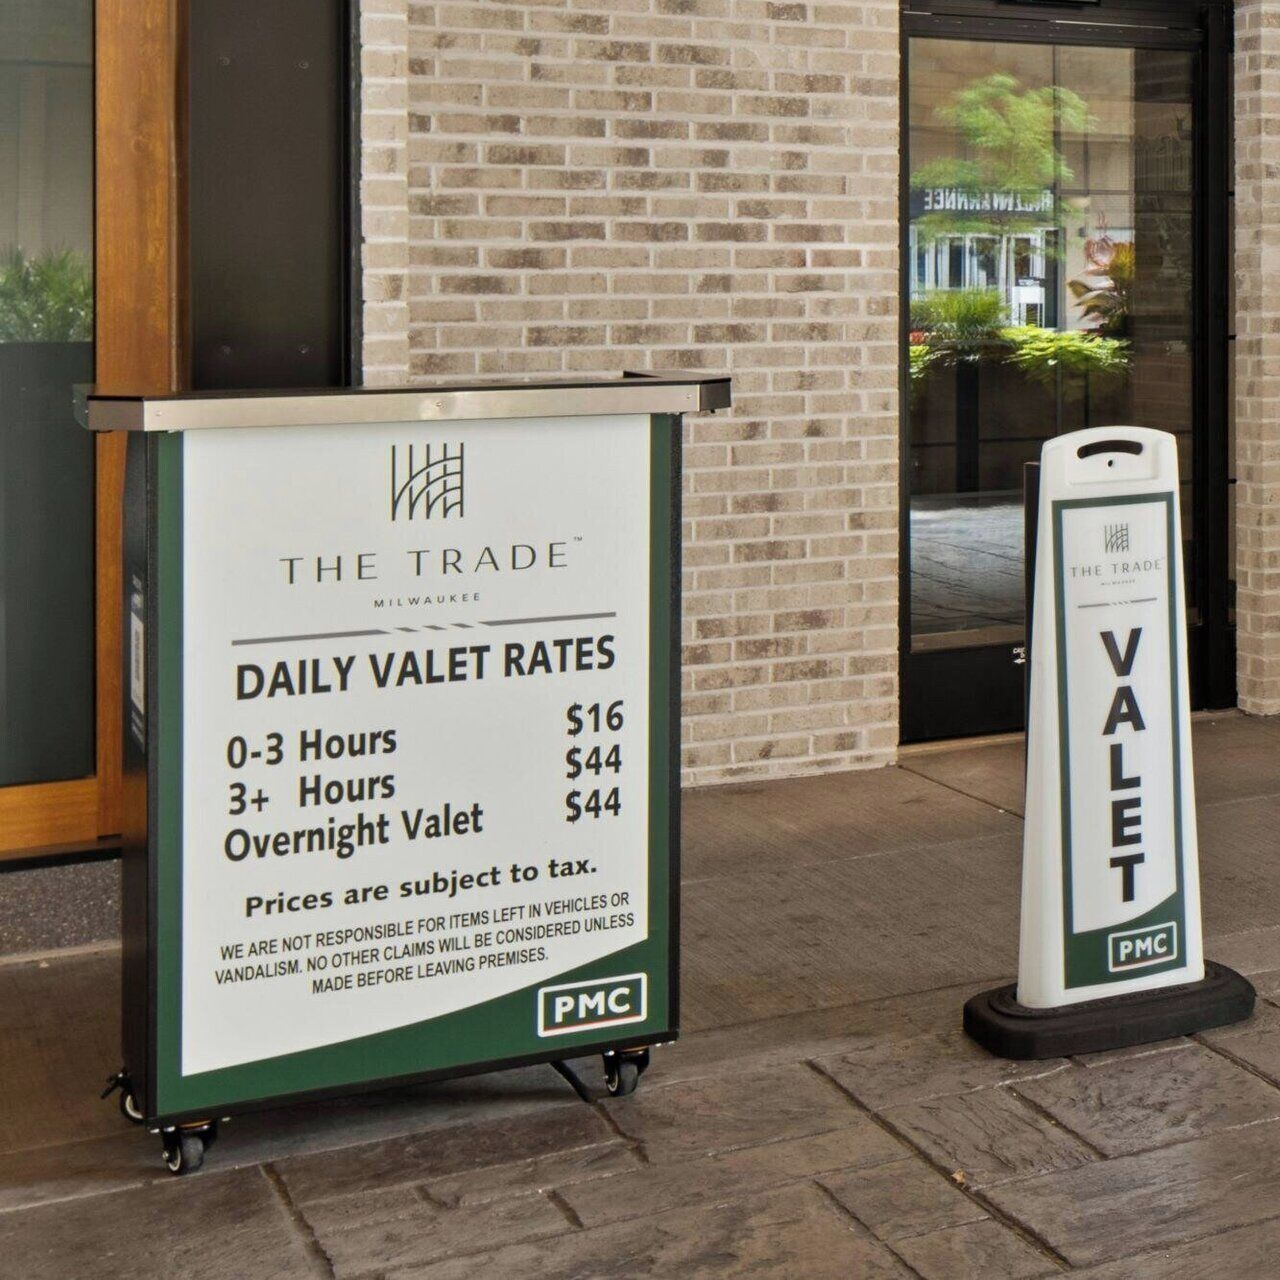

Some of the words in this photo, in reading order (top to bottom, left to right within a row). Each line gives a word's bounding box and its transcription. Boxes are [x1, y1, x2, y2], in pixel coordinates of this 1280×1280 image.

[279, 553, 378, 584] THE
[374, 592, 481, 608] MILWAUKEE
[1070, 565, 1102, 578] THE
[1112, 558, 1163, 575] TRADE
[236, 654, 355, 702] DAILY
[368, 645, 491, 691] VALET
[504, 634, 616, 678] RATES
[226, 731, 284, 769] 0-3
[299, 728, 397, 762] Hours
[565, 699, 624, 737] $16
[1100, 627, 1146, 903] VALET
[228, 782, 270, 816] 3+
[299, 773, 396, 808] Hours
[565, 743, 622, 781] $44
[224, 812, 390, 862] Overnight
[401, 802, 484, 841] Valet
[565, 786, 622, 824] $44
[245, 891, 333, 918] Prices
[344, 884, 389, 905] are
[399, 866, 501, 898] subject
[510, 863, 539, 883] to
[548, 858, 598, 879] tax.
[215, 958, 303, 985] VANDALISM.
[307, 955, 328, 972] NO
[331, 948, 380, 968] OTHER
[383, 940, 435, 961] CLAIMS
[438, 936, 470, 953] WILL
[474, 932, 492, 948] BE
[496, 920, 581, 944] CONSIDERED
[584, 912, 635, 933] UNLESS
[220, 943, 244, 961] WE
[247, 939, 278, 957] ARE
[282, 934, 312, 952] NOT
[316, 920, 414, 948] RESPONSIBLE
[418, 916, 446, 933] FOR
[449, 910, 489, 929] ITEMS
[493, 905, 525, 923] LEFT
[529, 902, 541, 919] IN
[544, 894, 607, 916] VEHICLES
[611, 891, 629, 907] OR
[1118, 931, 1169, 963] PMC
[312, 974, 354, 994] MADE
[357, 966, 414, 988] BEFORE
[418, 957, 475, 979] LEAVING
[479, 947, 549, 970] PREMISES.
[555, 987, 630, 1023] PMC
